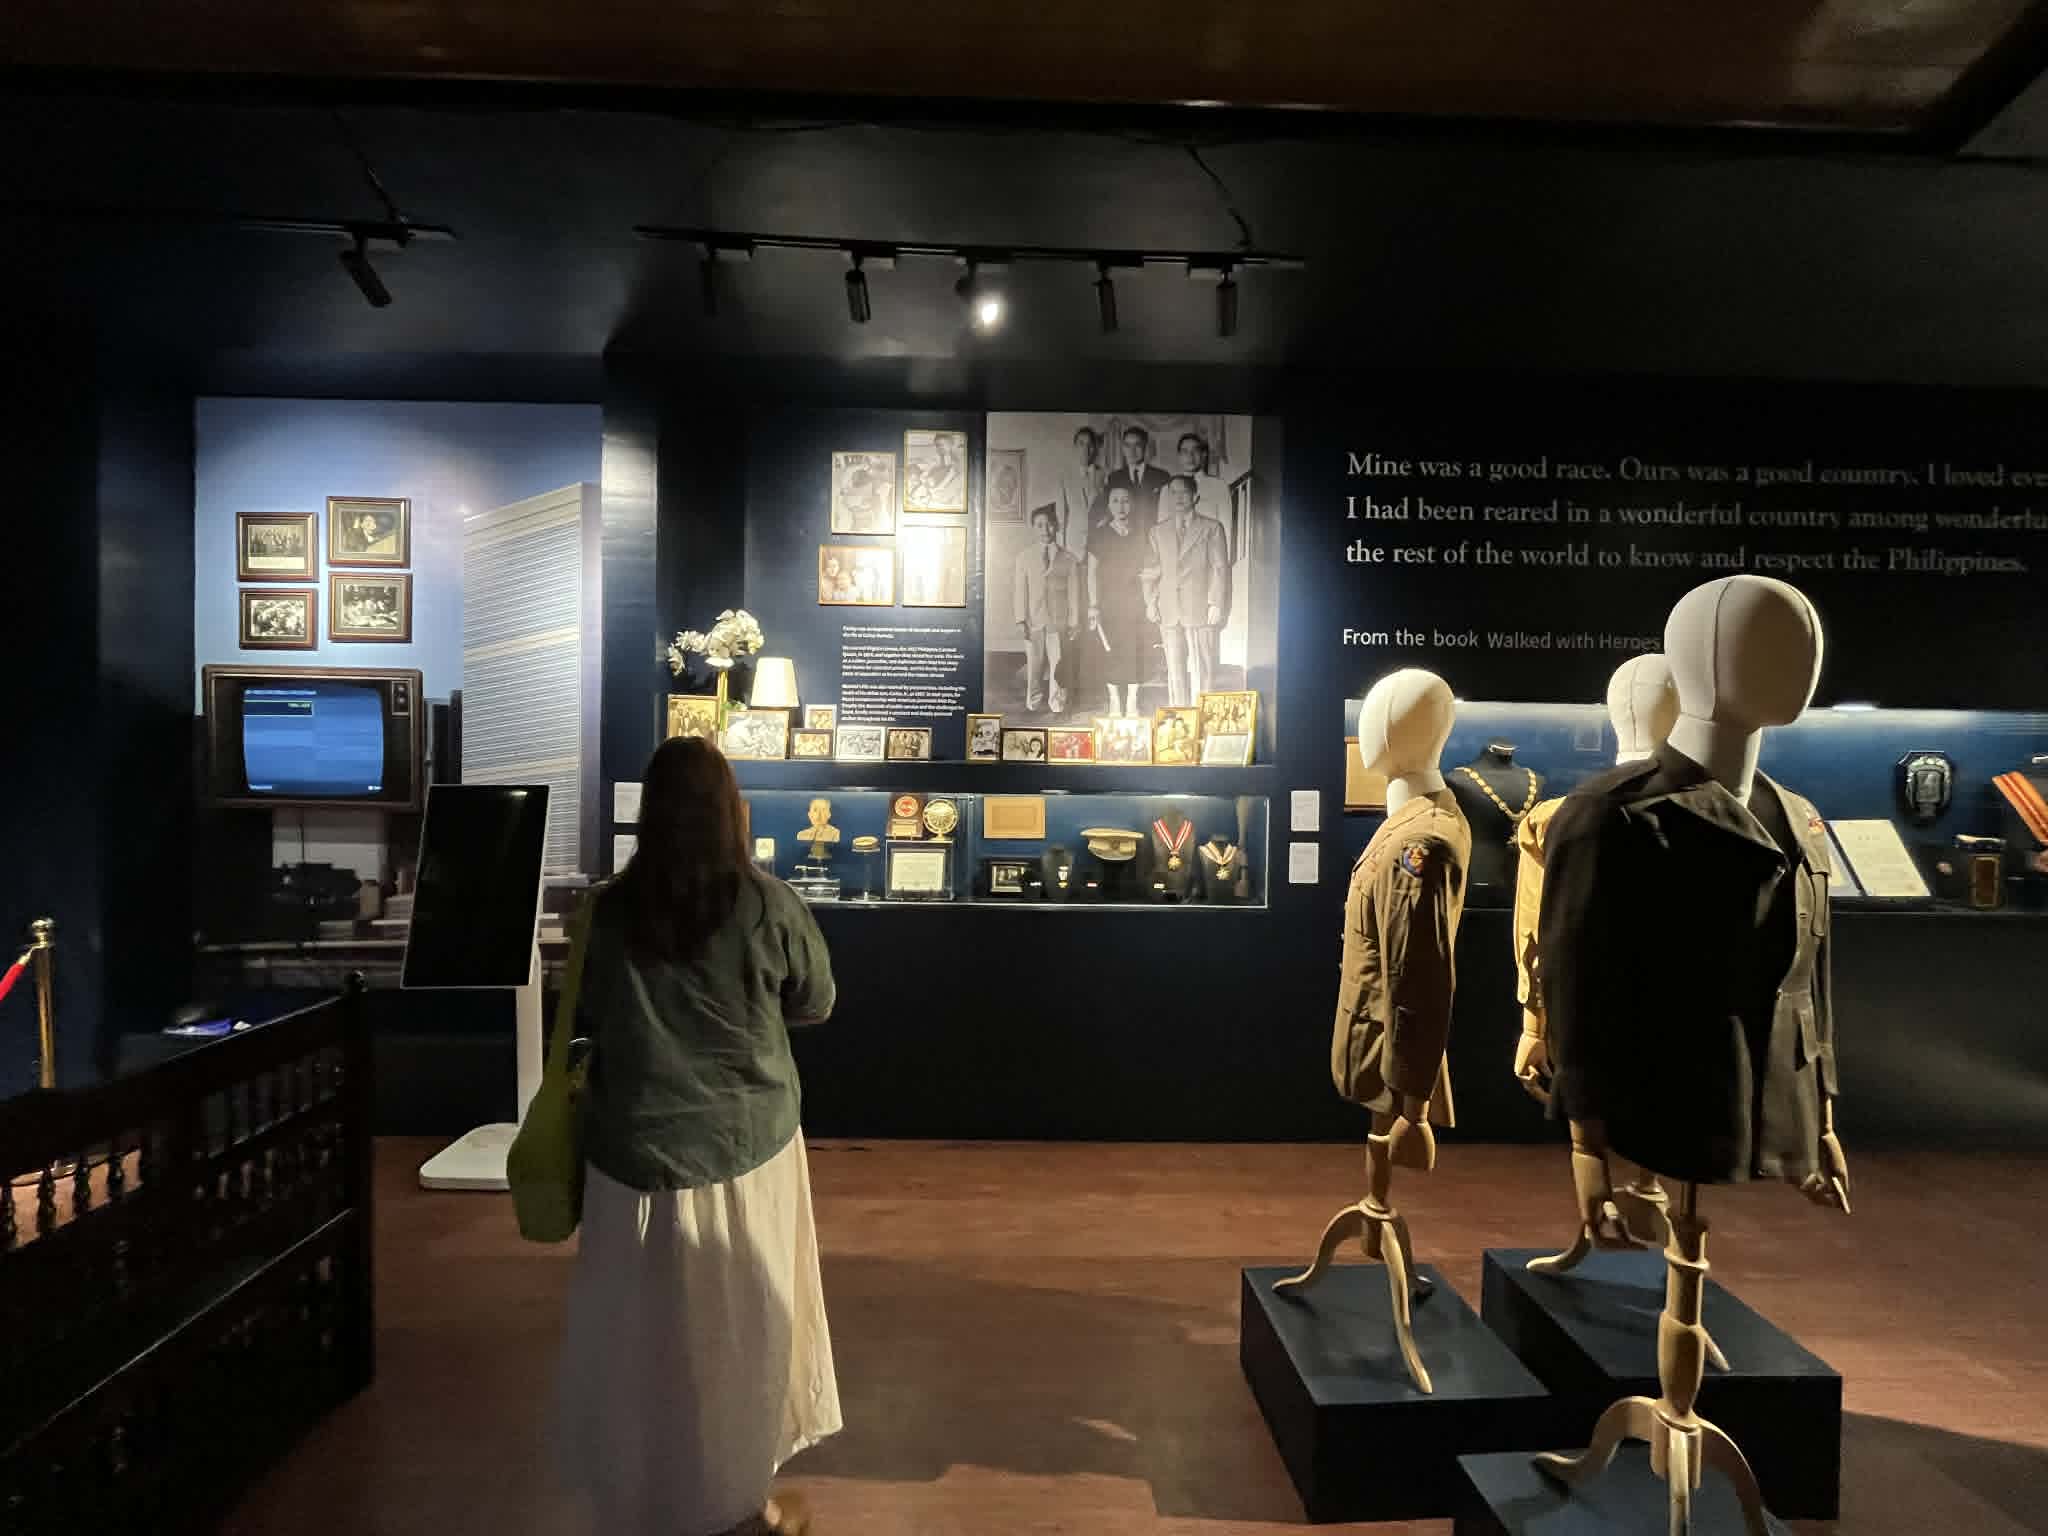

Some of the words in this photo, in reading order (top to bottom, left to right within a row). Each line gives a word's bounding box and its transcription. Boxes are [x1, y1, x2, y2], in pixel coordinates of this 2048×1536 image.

[1347, 452, 1412, 478] Mine
[1419, 459, 1462, 478] was
[1469, 461, 1483, 479] a
[1489, 456, 1549, 487] good
[1556, 461, 1612, 480] race.
[1619, 457, 1681, 481] Ours
[1687, 464, 1730, 482] was
[1736, 464, 1749, 482] a
[1755, 459, 1813, 488] good
[1927, 461, 1938, 483] I
[1944, 464, 2005, 486] loved
[1346, 496, 1358, 519] I
[1364, 497, 1410, 520] had
[1417, 498, 1474, 521] been
[1482, 498, 1559, 523] reared
[1567, 500, 1591, 523] in
[1599, 507, 1613, 524] a
[1618, 500, 1743, 526] wonderful
[1748, 508, 1840, 530] country
[1847, 512, 1929, 533] among
[1346, 539, 1385, 563] the
[1392, 545, 1436, 563] rest
[1443, 540, 1470, 564] of
[1475, 541, 1514, 565] the
[1520, 544, 1589, 566] world
[1598, 546, 1622, 567] to
[1629, 544, 1692, 567] know
[1700, 545, 1745, 568] and
[1754, 550, 1836, 572] respect
[1842, 548, 1881, 570] the
[1343, 628, 1390, 646] From
[1395, 628, 1425, 646] the
[1433, 629, 1480, 647] book
[1487, 631, 1552, 648] Walked
[1557, 631, 1595, 649] with
